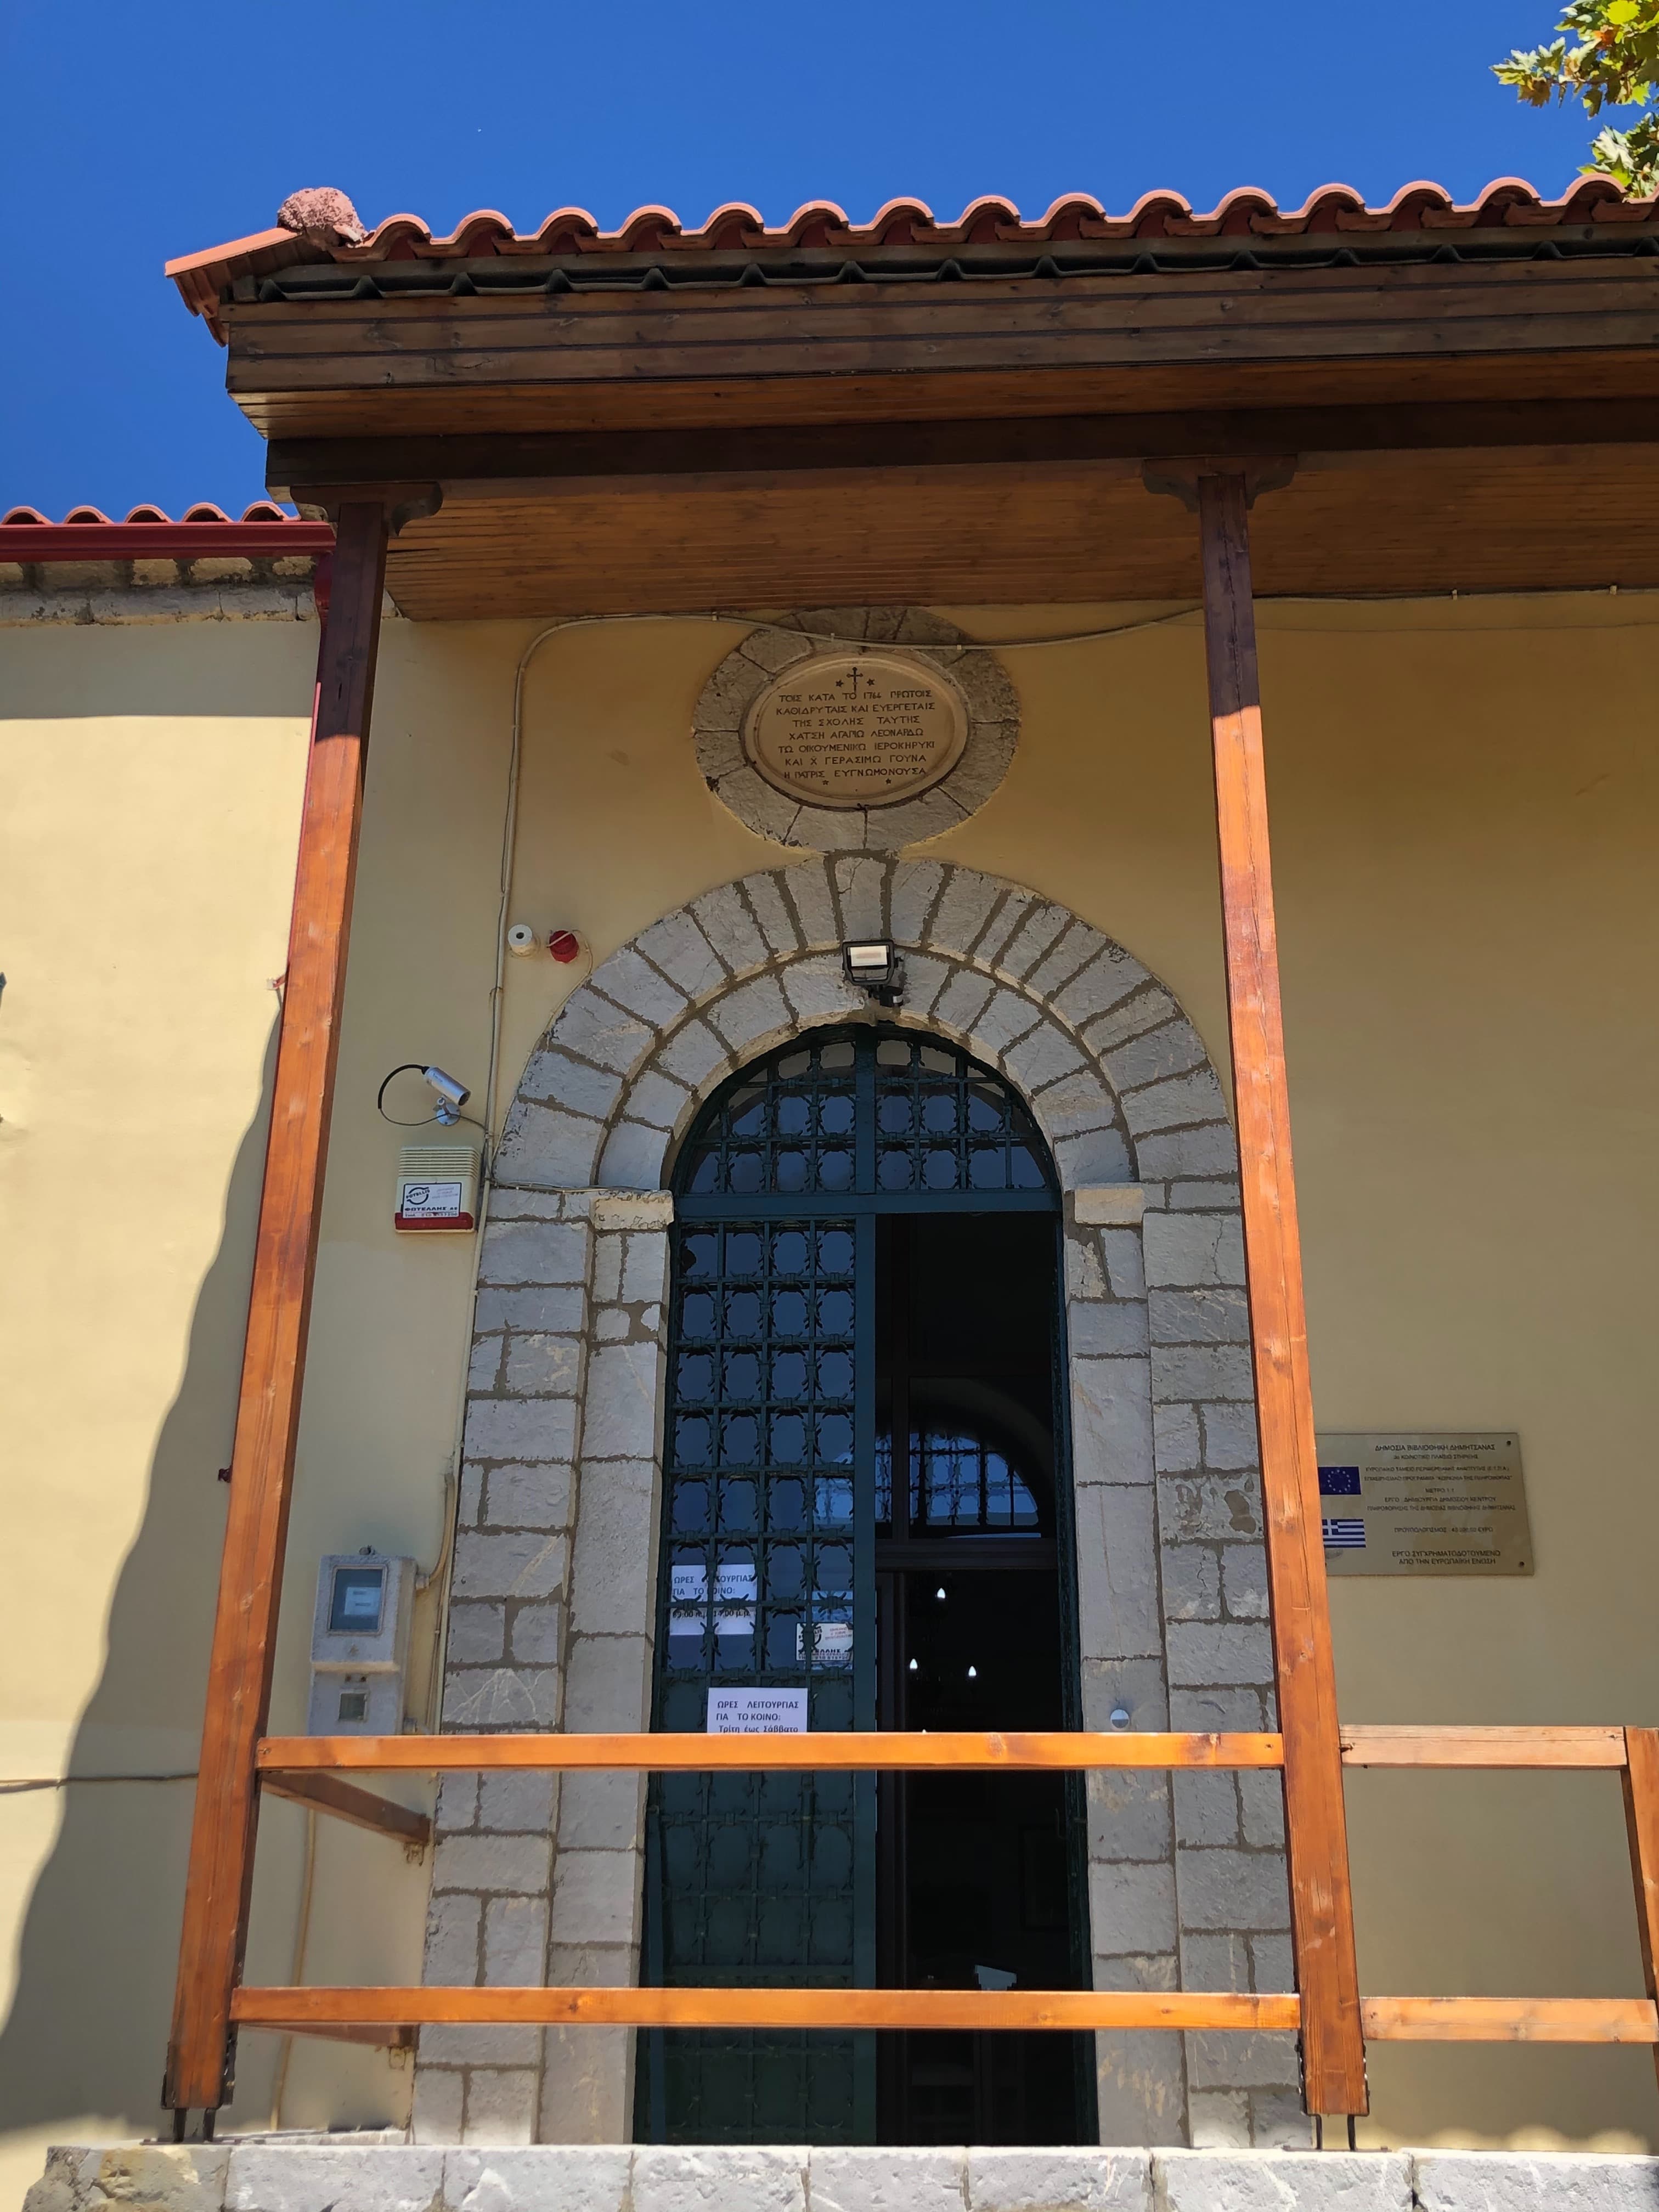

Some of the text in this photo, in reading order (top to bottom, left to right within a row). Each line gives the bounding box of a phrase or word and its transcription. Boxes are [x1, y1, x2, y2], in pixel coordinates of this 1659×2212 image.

[890, 690, 932, 698] ΠΡΩΤΟΙΣ
[873, 702, 935, 712] ΕΥΕΡΓΕΤΑΙΣ
[819, 717, 864, 726] ΣΧΟΛΗΣ
[877, 715, 920, 724] ΤΑΥΤΗΣ
[789, 732, 825, 740] ΧΑΤΣΗ
[871, 727, 923, 737] ΛΕΟΝΑΡΔΩ
[798, 743, 866, 752] ΟΙΚΟΥΜΕΝΙΚΩ
[874, 741, 935, 750] ΙΕΡΟΚΗΡΥΚΙ
[825, 755, 881, 765] ΓΕΡΑΣΙΜΩ
[889, 754, 927, 763] ΓΟΥΝΑ
[794, 770, 825, 778] ΠΑΤΡΙΣ
[834, 768, 927, 777] ΕΥΓΝΩΜΟΝΟΥΣΑ
[707, 1575, 752, 1583] ΟΥΡΓΙΑΣ
[710, 1587, 735, 1595] ΟΙΝΟ:
